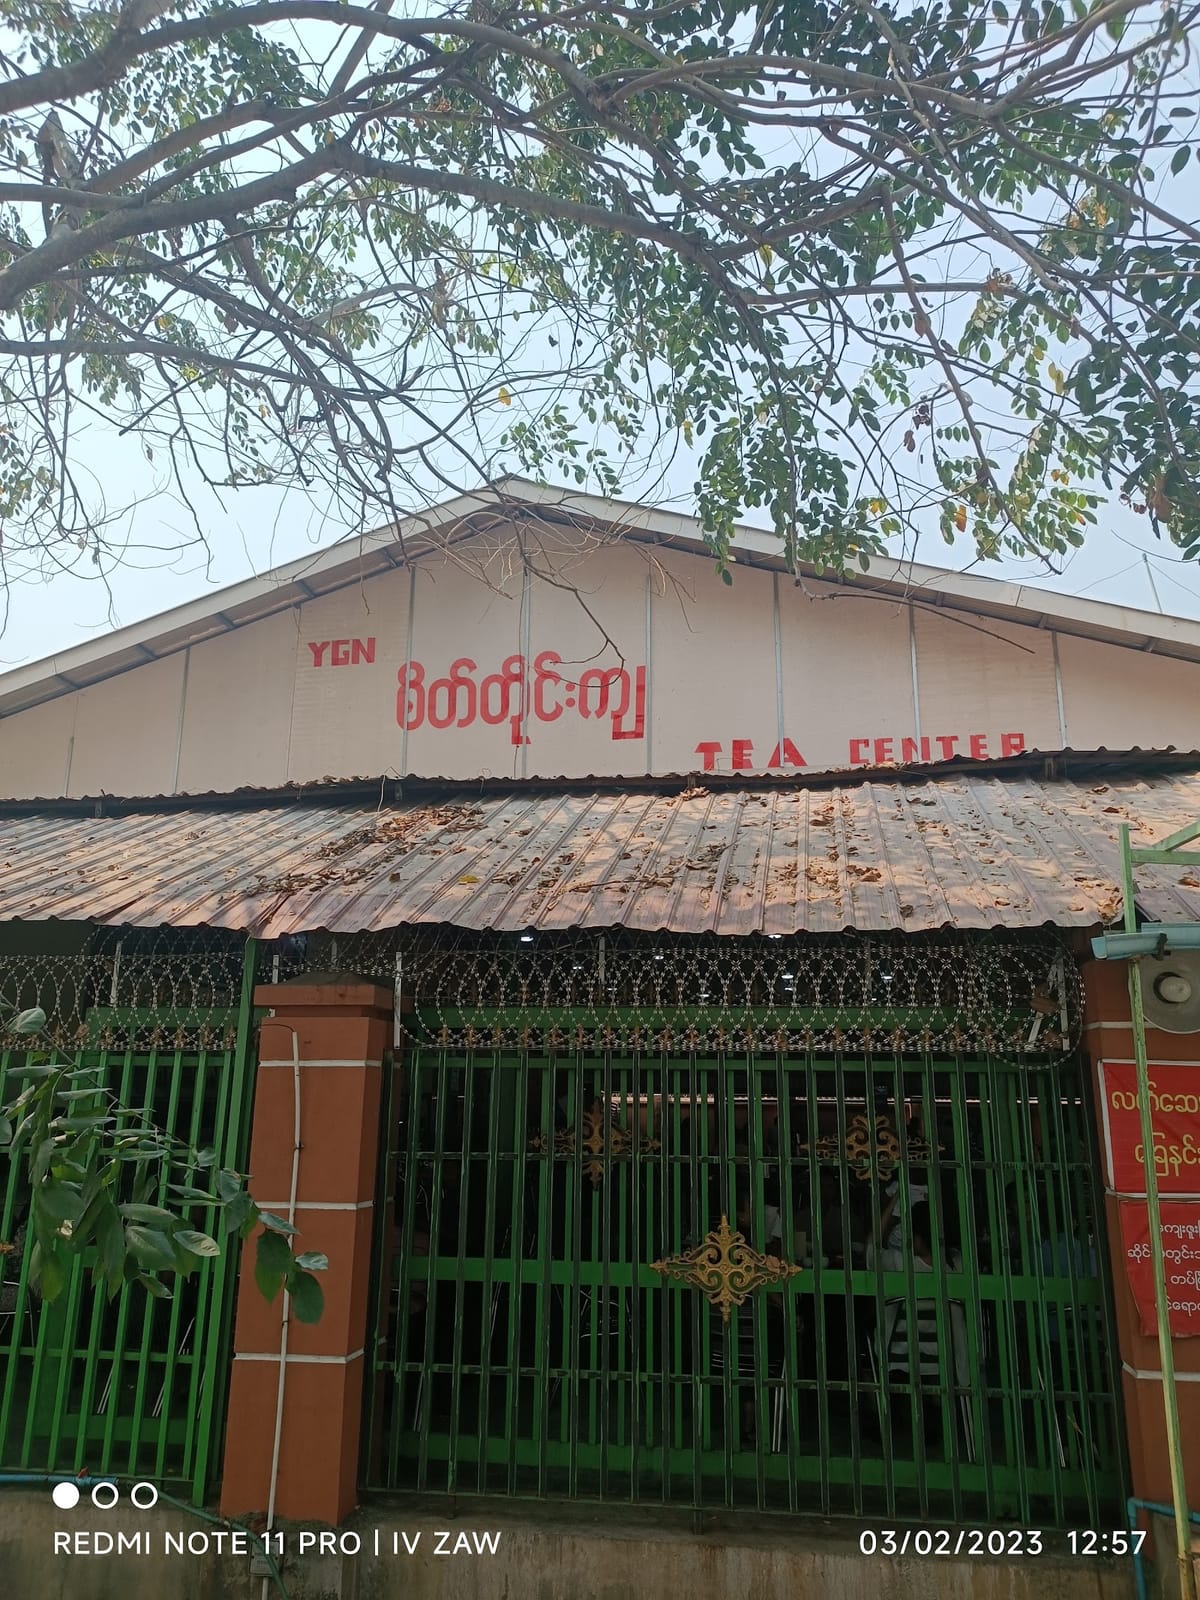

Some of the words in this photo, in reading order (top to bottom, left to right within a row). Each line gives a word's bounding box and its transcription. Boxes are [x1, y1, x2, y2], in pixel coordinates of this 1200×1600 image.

[307, 637, 376, 667] YGN
[694, 737, 808, 771] TEA
[848, 733, 1025, 765] CENTER
